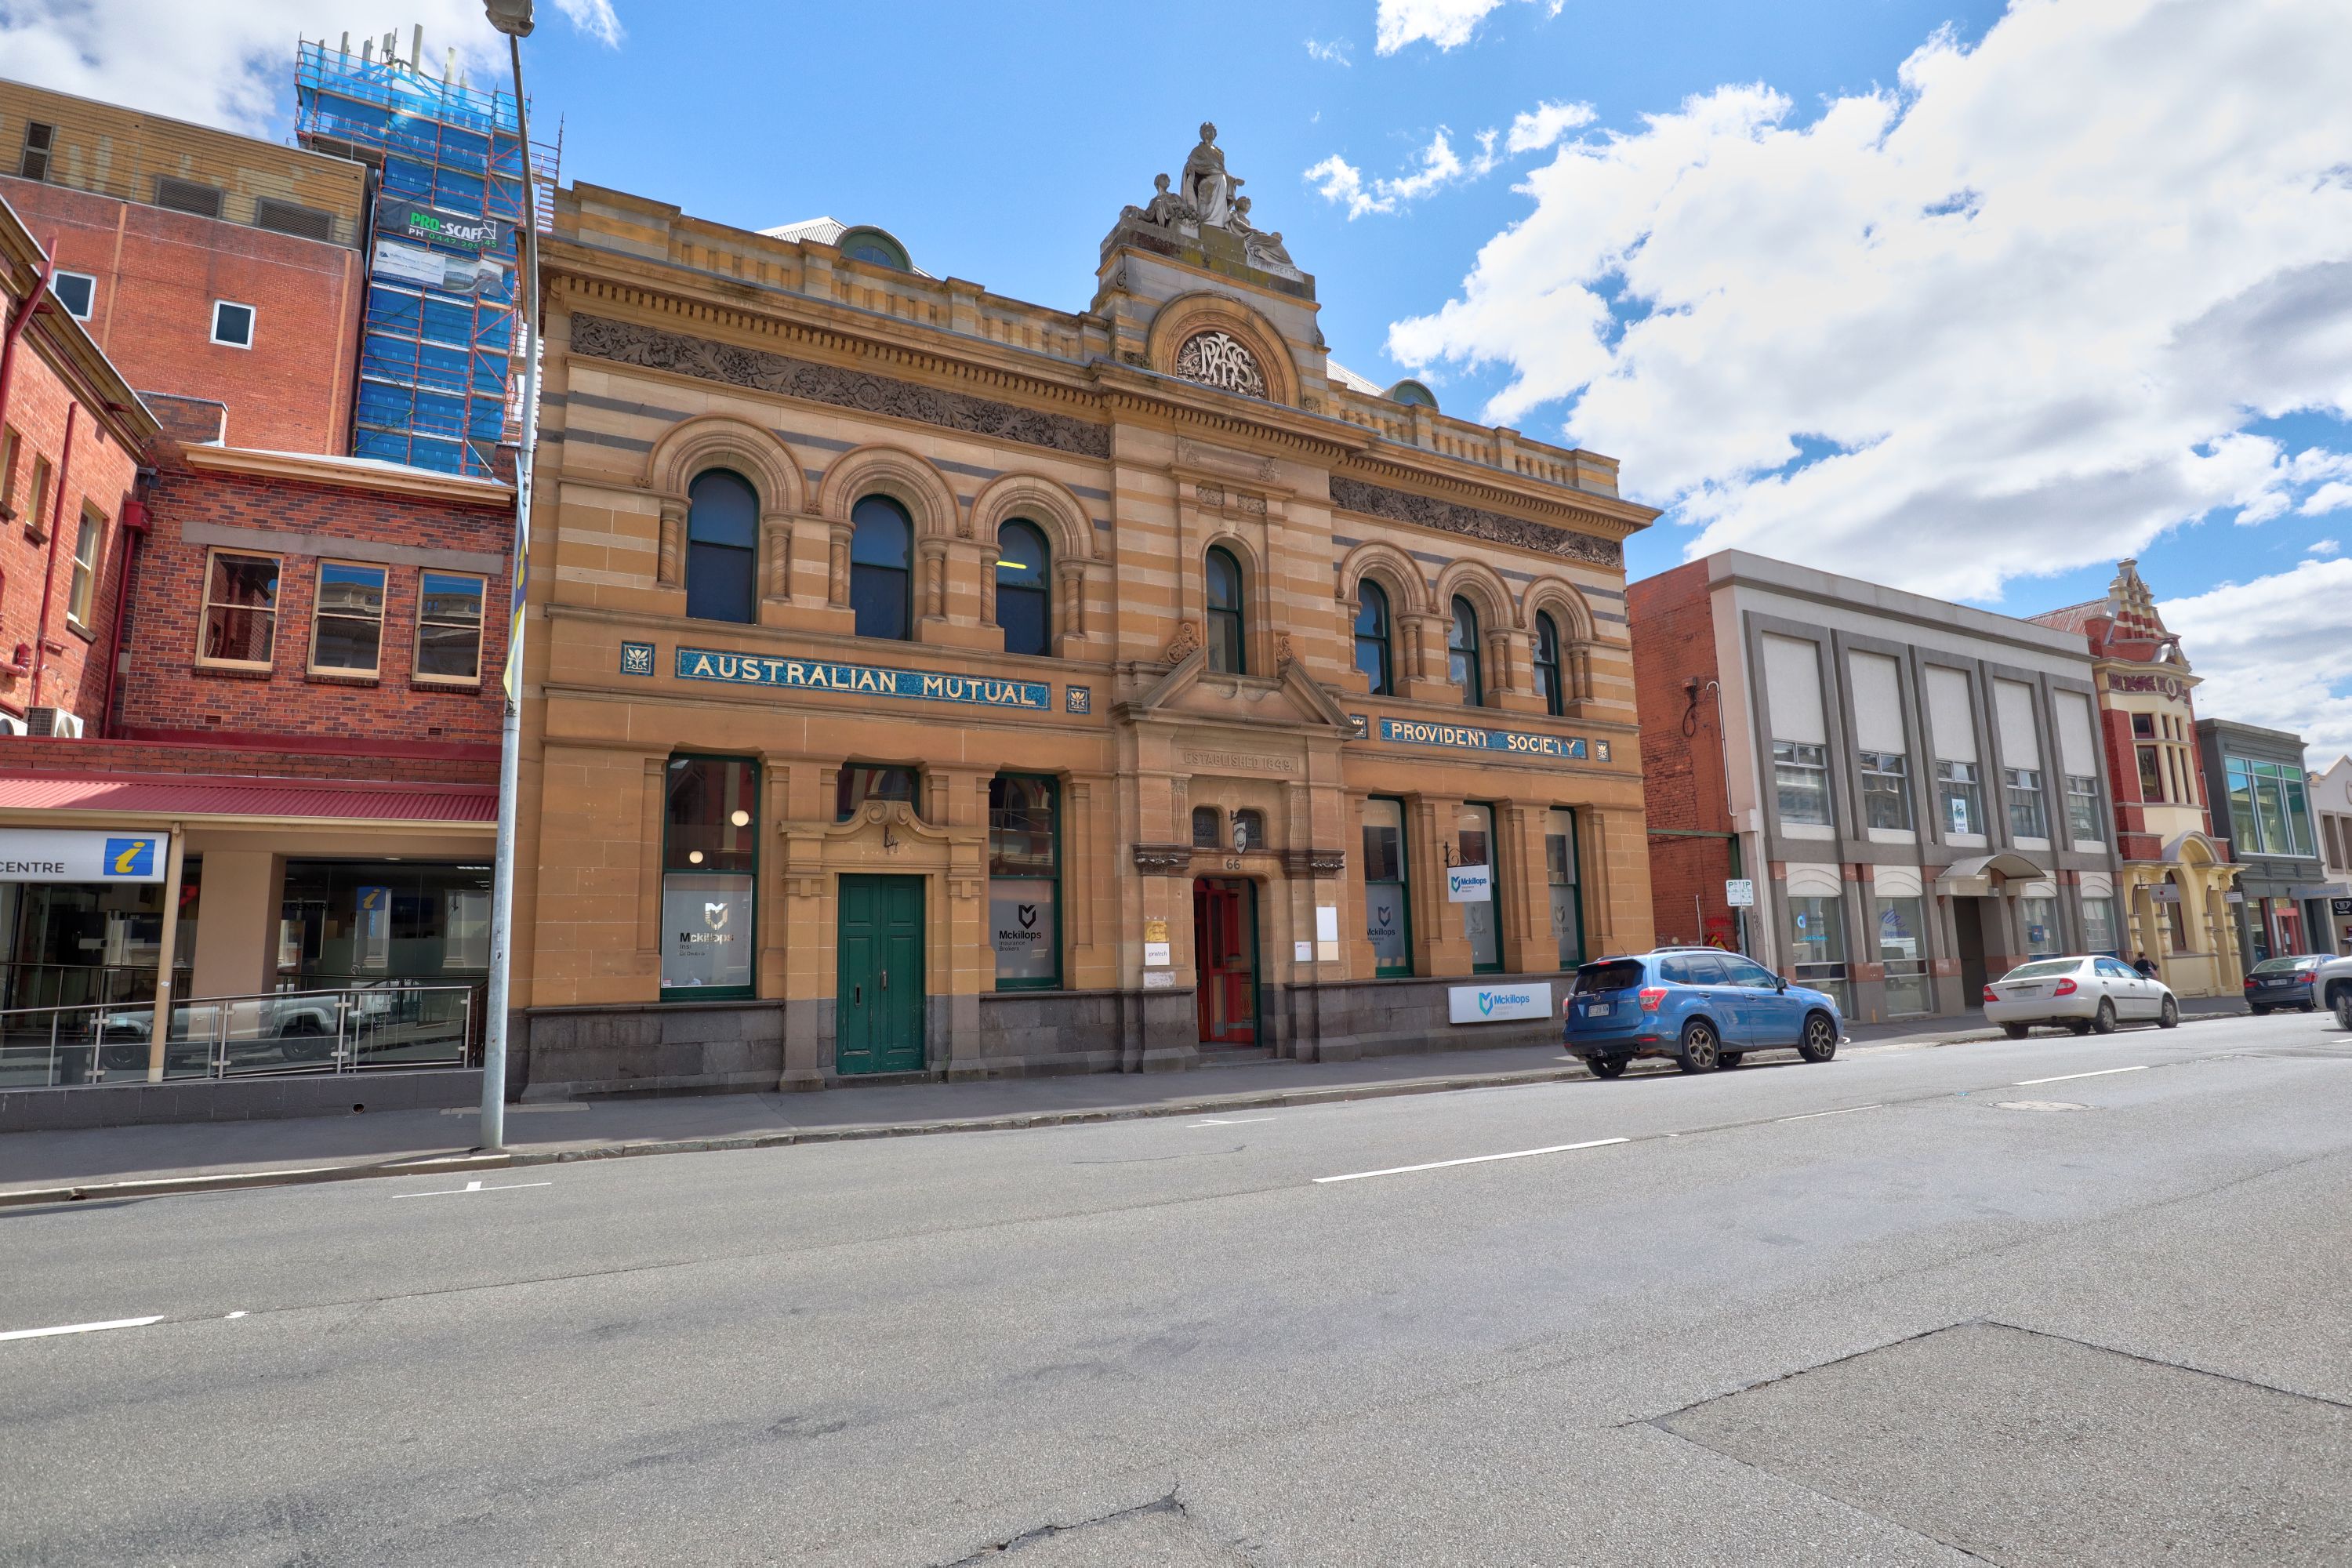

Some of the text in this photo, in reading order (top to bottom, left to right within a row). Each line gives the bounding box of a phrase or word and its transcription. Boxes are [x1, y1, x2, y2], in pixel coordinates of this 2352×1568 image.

[410, 212, 483, 239] PRO-SCAFF
[408, 228, 423, 237] PH
[693, 654, 1036, 705] AUSTRALIAN MUTUAL
[1392, 723, 1575, 755] PROVIDENT SOCIETY
[1185, 751, 1258, 768] ESTABLISHED
[1226, 859, 1240, 870] 66
[1461, 877, 1486, 886] Mckillops
[999, 931, 1042, 941] Mckillops
[1494, 994, 1530, 1006] Mckillops
